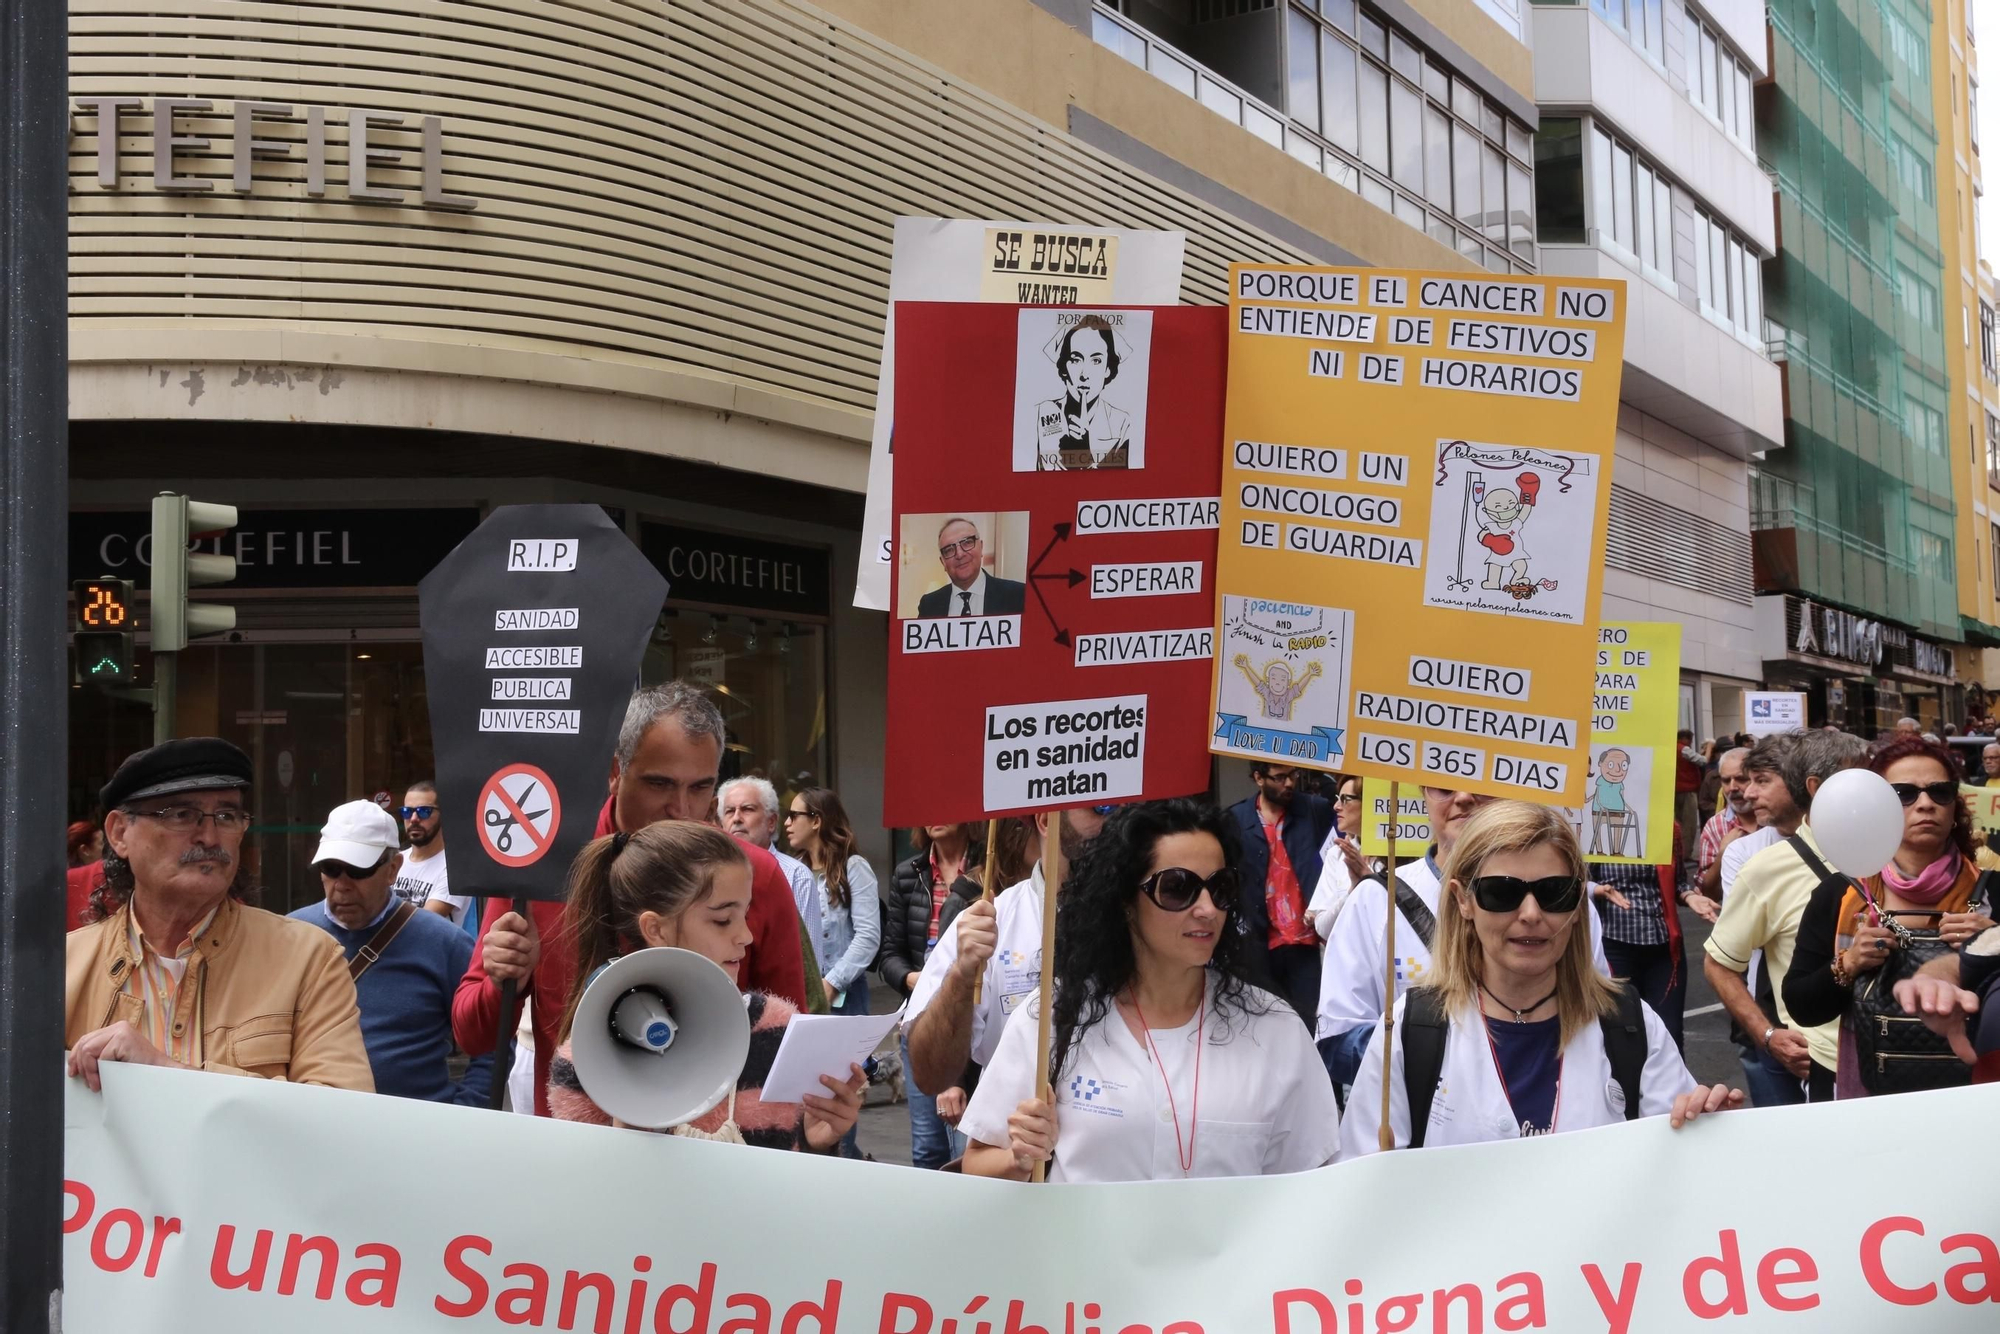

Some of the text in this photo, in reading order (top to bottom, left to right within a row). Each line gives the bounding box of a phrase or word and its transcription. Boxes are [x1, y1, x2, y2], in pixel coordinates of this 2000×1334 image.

[69, 98, 478, 211] TEFIEL
[994, 232, 1108, 276] SE BUSCA
[1018, 282, 1078, 305] WANTED
[1239, 273, 1607, 318] PORQUE EL CANCER NO
[1057, 313, 1124, 326] POR FAVOR
[1239, 307, 1588, 358] ENTIENDE DE FESTIVOS
[1312, 351, 1579, 397] NI DE HORARIOS
[1040, 451, 1125, 465] NO TE CALLES
[1235, 442, 1403, 481] QUIERO UN
[1455, 446, 1568, 471] Pelones Peleones
[1077, 502, 1220, 529] CONCERTAR
[1240, 485, 1398, 524] ONCOLOGO
[101, 530, 361, 566] CEFIEL
[511, 542, 574, 568] R.I.P.
[1241, 522, 1415, 566] DE GUARDIA
[667, 546, 806, 595] CORTEFIEL
[1092, 566, 1195, 594] ESPERAR
[84, 587, 125, 625] 26
[496, 611, 577, 630] SANIDAD
[905, 619, 1013, 651] BALTAR
[1230, 624, 1327, 651] finish la RADIO
[1275, 620, 1292, 630] AND
[487, 648, 580, 668] ACCESIBLE
[1078, 633, 1213, 662] PRIVATIZAR
[1624, 651, 1646, 666] DE
[493, 680, 567, 699] PUBLICA
[1412, 660, 1525, 696] QUIERO
[481, 711, 579, 731] UNIVERSAL
[988, 704, 1144, 741] Los recortes
[1358, 693, 1570, 747] RADIOTERAPIA
[996, 733, 1140, 771] en sanidad
[1233, 729, 1318, 759] LOVE U DAD
[1361, 737, 1560, 790] LOS 365 DIAS
[1027, 771, 1108, 800] matan
[209, 1225, 402, 1309] una
[434, 1235, 843, 1334] Sanidad
[1580, 1262, 1643, 1334] y
[1682, 1228, 1820, 1319] de
